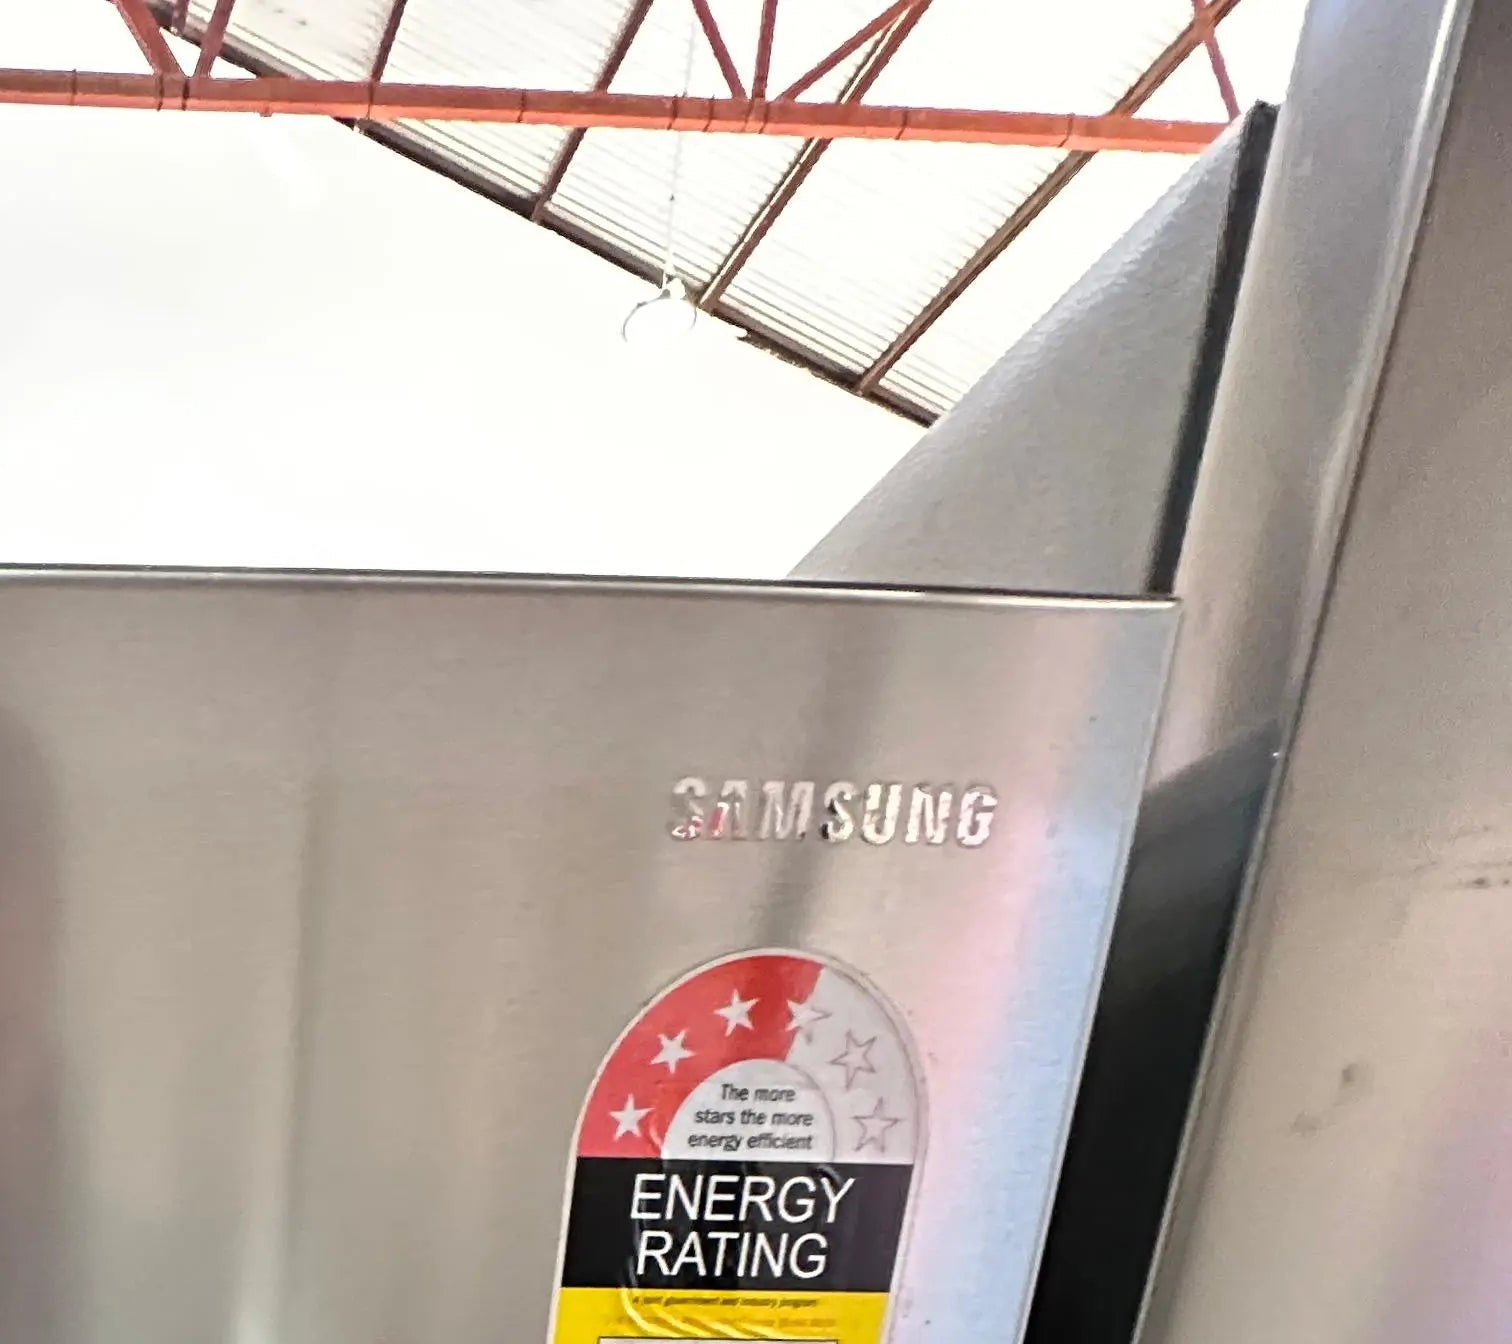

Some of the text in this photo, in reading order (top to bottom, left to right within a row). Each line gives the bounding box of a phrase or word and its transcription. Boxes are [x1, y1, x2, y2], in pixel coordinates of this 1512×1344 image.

[670, 776, 999, 847] SAMSUNG
[721, 1083, 796, 1102] The more
[695, 1108, 814, 1126] stars the more
[688, 1132, 814, 1152] energy efficient
[630, 1173, 856, 1224] ENERGY
[636, 1230, 829, 1279] RATING
